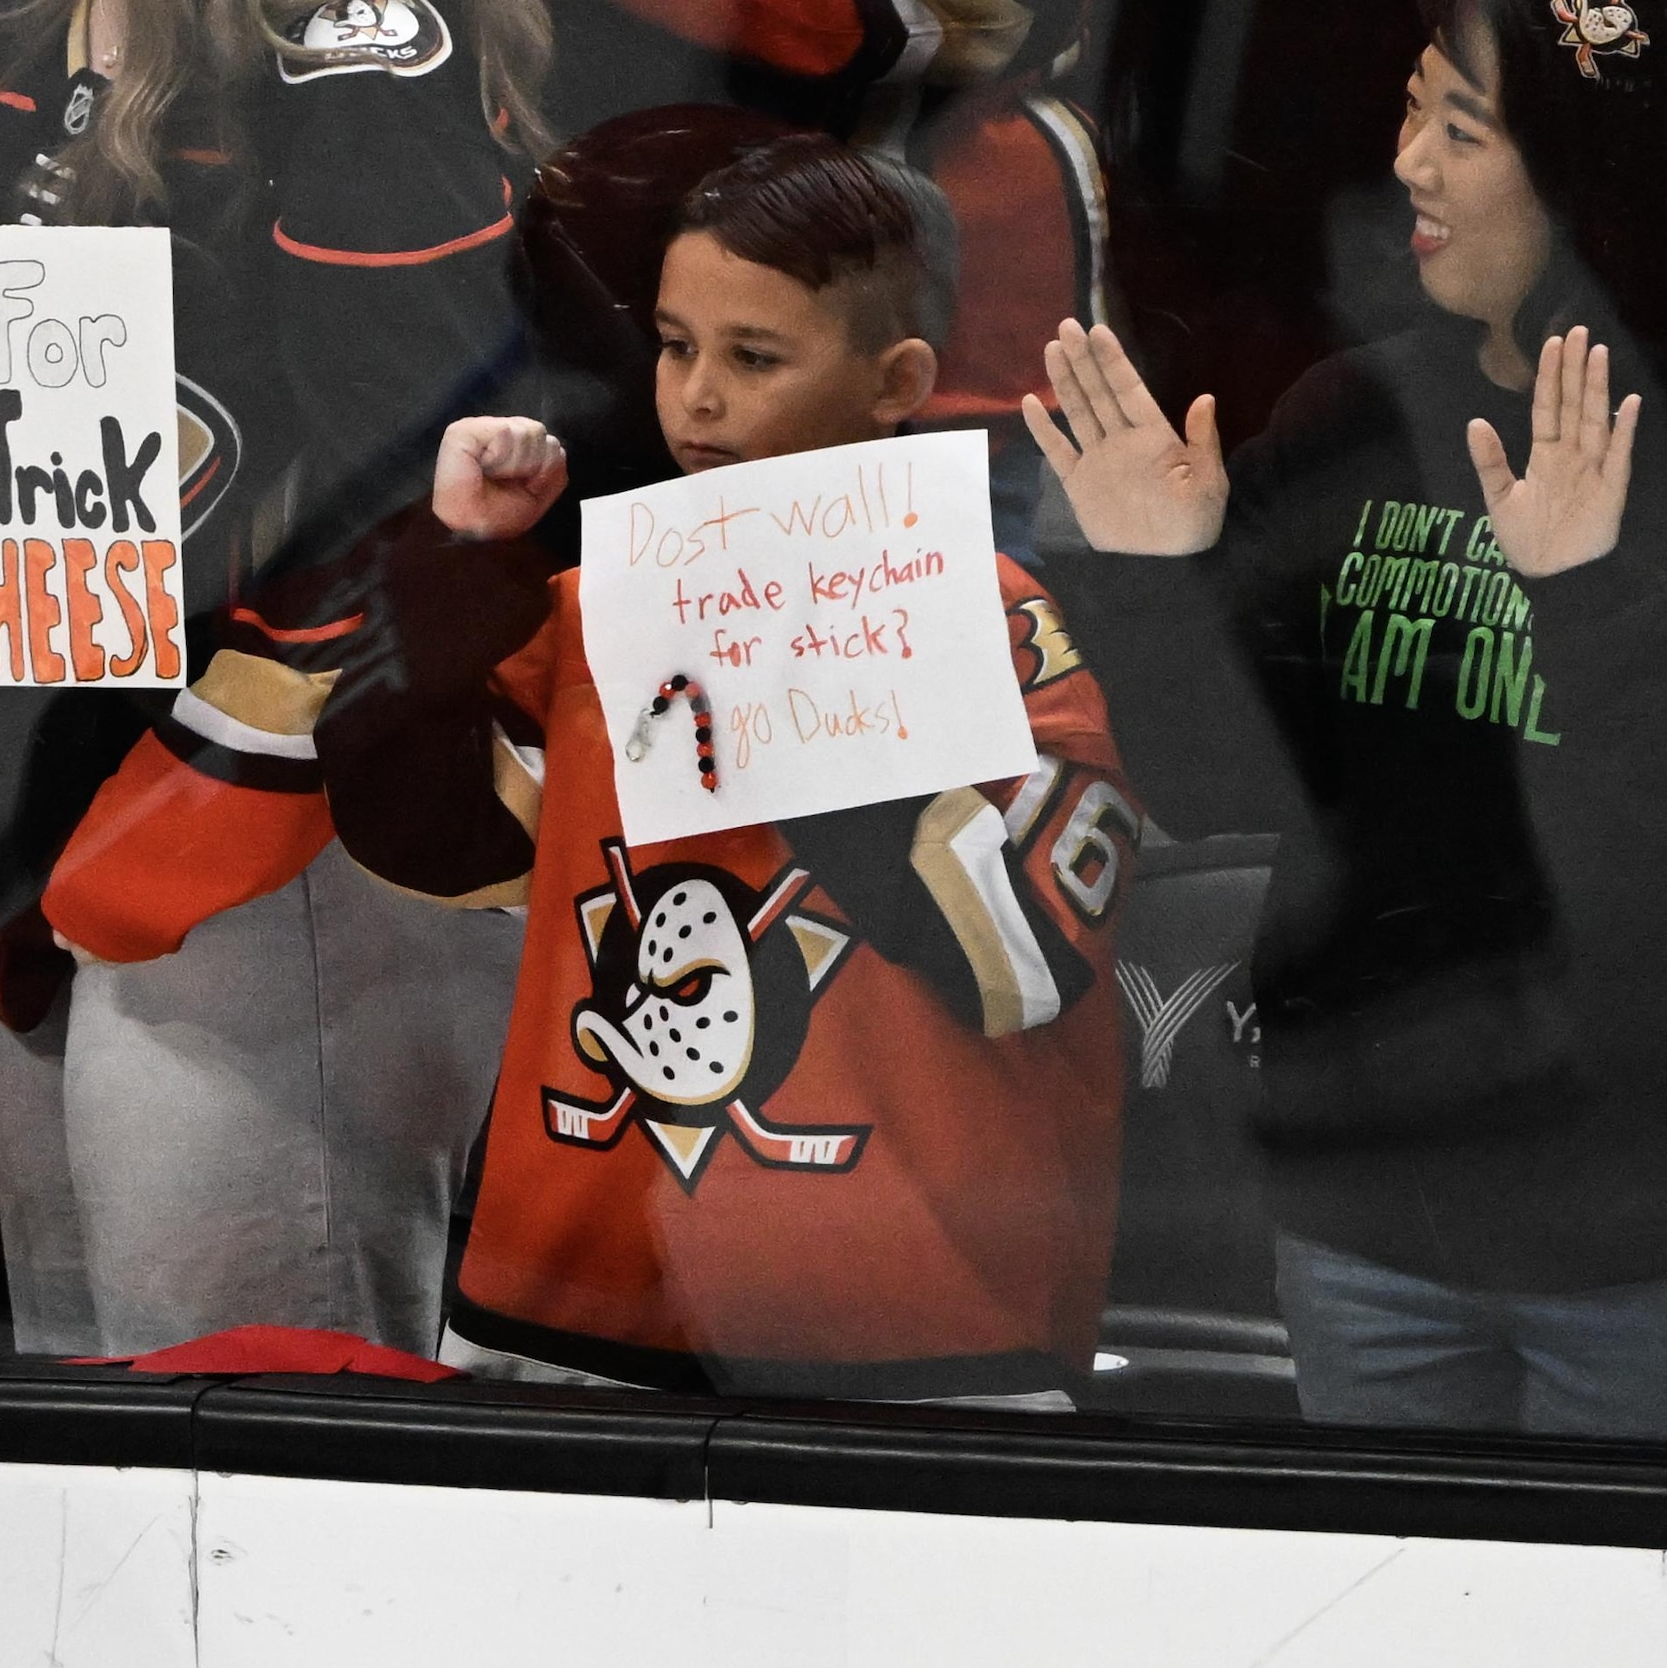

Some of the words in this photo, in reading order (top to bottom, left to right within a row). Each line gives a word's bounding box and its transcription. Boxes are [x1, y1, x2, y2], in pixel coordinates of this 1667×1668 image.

[770, 462, 919, 539] wall!
[1353, 499, 1372, 547] I
[1374, 501, 1465, 555] DON'T
[672, 569, 786, 625] trade
[810, 547, 944, 610] keychain
[1336, 551, 1535, 631] COMMOTION
[710, 629, 763, 668] for
[791, 607, 913, 660] stick?
[1340, 609, 1436, 710] AM
[730, 706, 772, 769] go
